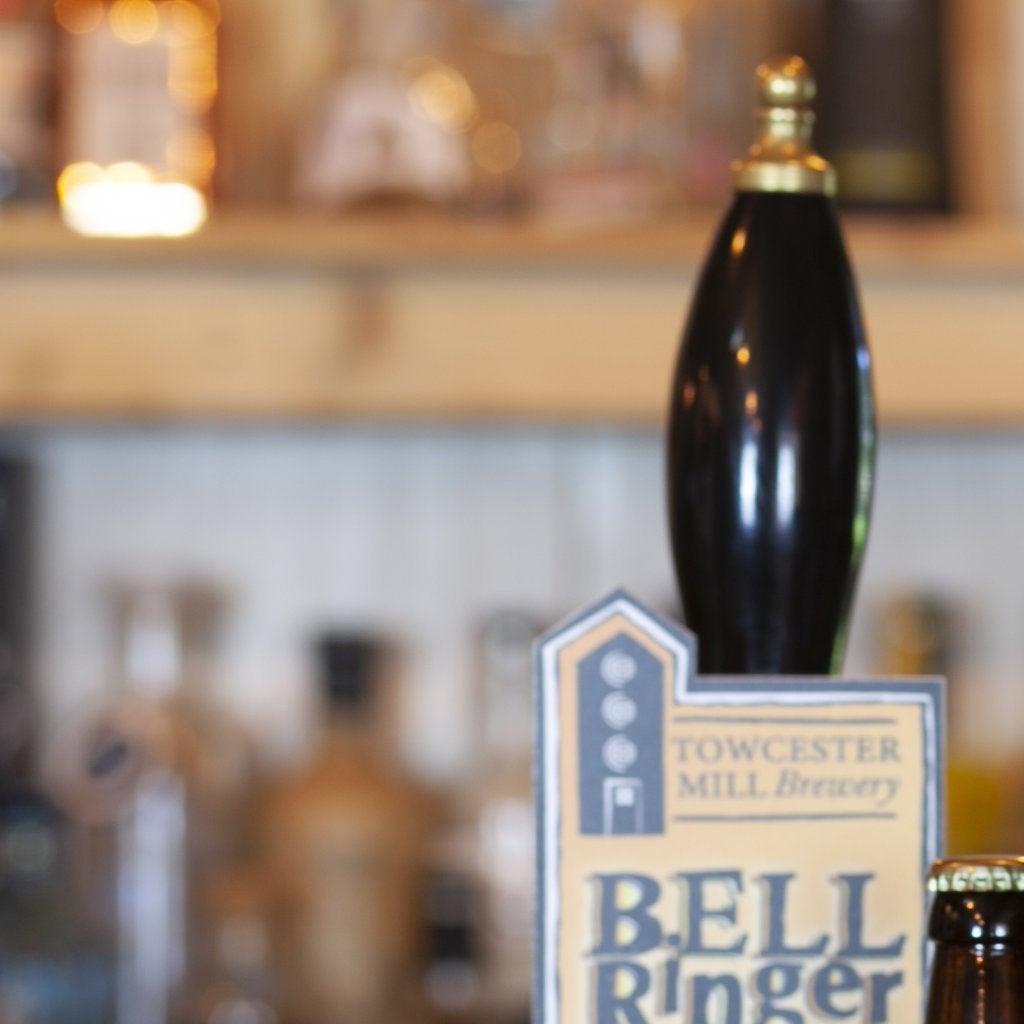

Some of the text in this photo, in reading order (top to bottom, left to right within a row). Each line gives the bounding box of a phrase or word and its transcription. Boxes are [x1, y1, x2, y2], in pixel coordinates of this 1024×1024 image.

[673, 735, 902, 764] TOWCESTER
[679, 770, 902, 808] MILL Brewery
[584, 869, 907, 957] BELL
